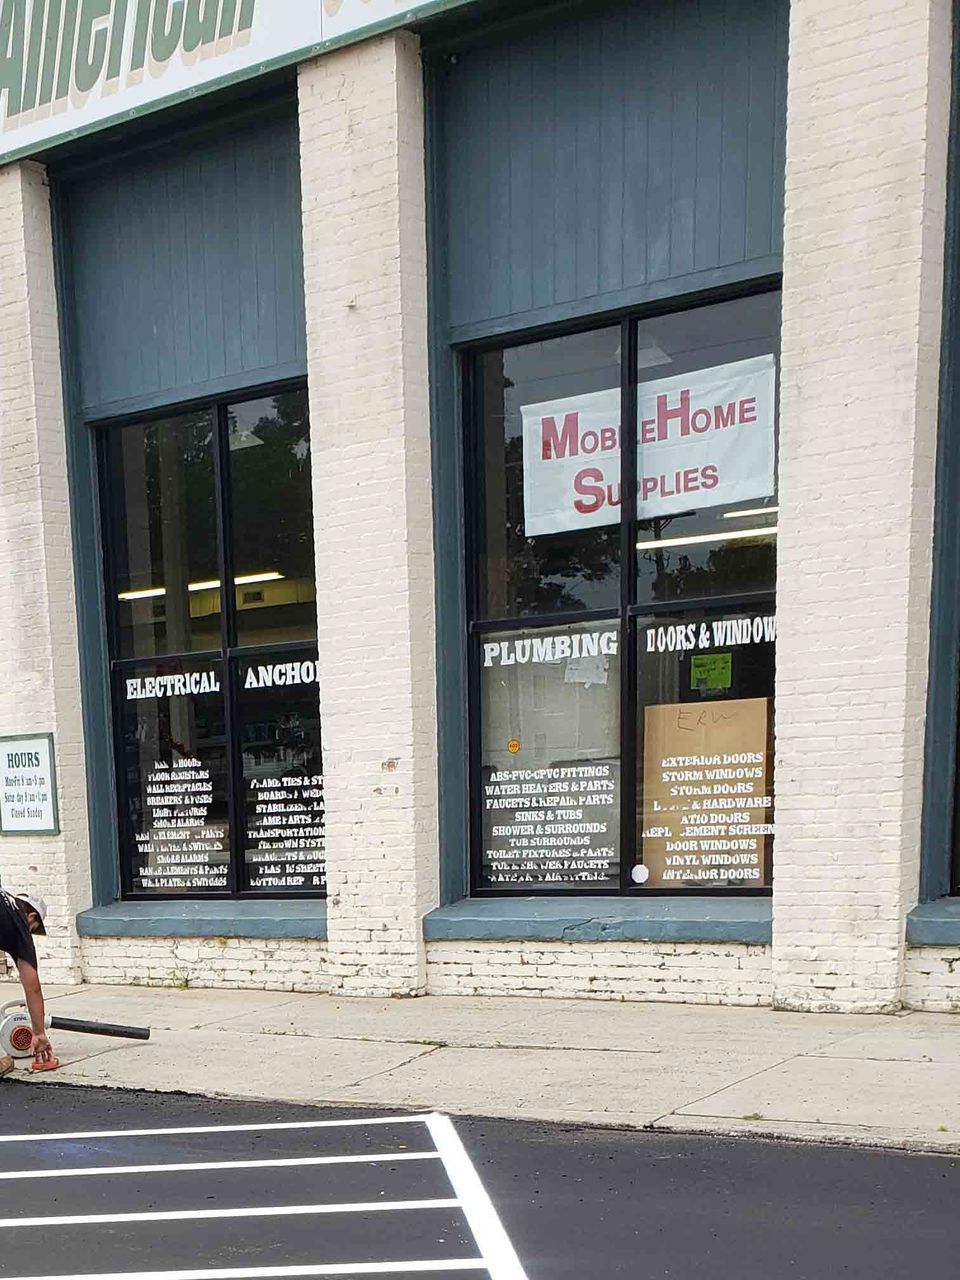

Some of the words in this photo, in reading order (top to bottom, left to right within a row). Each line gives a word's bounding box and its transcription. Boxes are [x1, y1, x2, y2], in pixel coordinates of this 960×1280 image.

[541, 412, 656, 461] MOBE
[656, 389, 758, 442] HOME
[573, 464, 720, 514] SUPLIES
[646, 623, 696, 653] DOORS
[698, 622, 710, 649] &
[484, 631, 618, 667] PLUMBING
[126, 671, 220, 700] ELECTRICAL
[6, 751, 40, 769] HOURS
[723, 752, 764, 765] DOORS
[560, 766, 609, 778] FITTINGS
[662, 770, 703, 782] STORM
[704, 767, 762, 780] WINDOWS
[282, 777, 302, 787] TIES
[303, 776, 310, 786] &
[485, 785, 520, 795] WATER
[522, 782, 569, 794] HEATERS
[571, 782, 579, 792] &
[579, 780, 615, 791] PARTS
[713, 782, 754, 794] DOORS
[486, 798, 532, 809] FAUCETS
[579, 794, 614, 806] PARTS
[691, 800, 700, 810] &
[702, 796, 772, 809] HARDWARE
[515, 811, 545, 822] SINKS
[546, 810, 554, 821] &
[556, 809, 583, 820] TUBS
[709, 812, 750, 823] DOORS
[492, 825, 534, 836] SHOWER
[535, 825, 544, 835] &
[544, 822, 607, 834] SURROUNDS
[509, 837, 529, 847] TUB
[530, 836, 591, 846] SURROUNDS
[666, 841, 698, 851] DOOR
[699, 839, 757, 850] WINDOWS
[665, 855, 699, 866] VINYL
[700, 853, 758, 865] WINDOWS
[259, 864, 295, 874] PLASIC
[720, 868, 760, 879] DOORS
